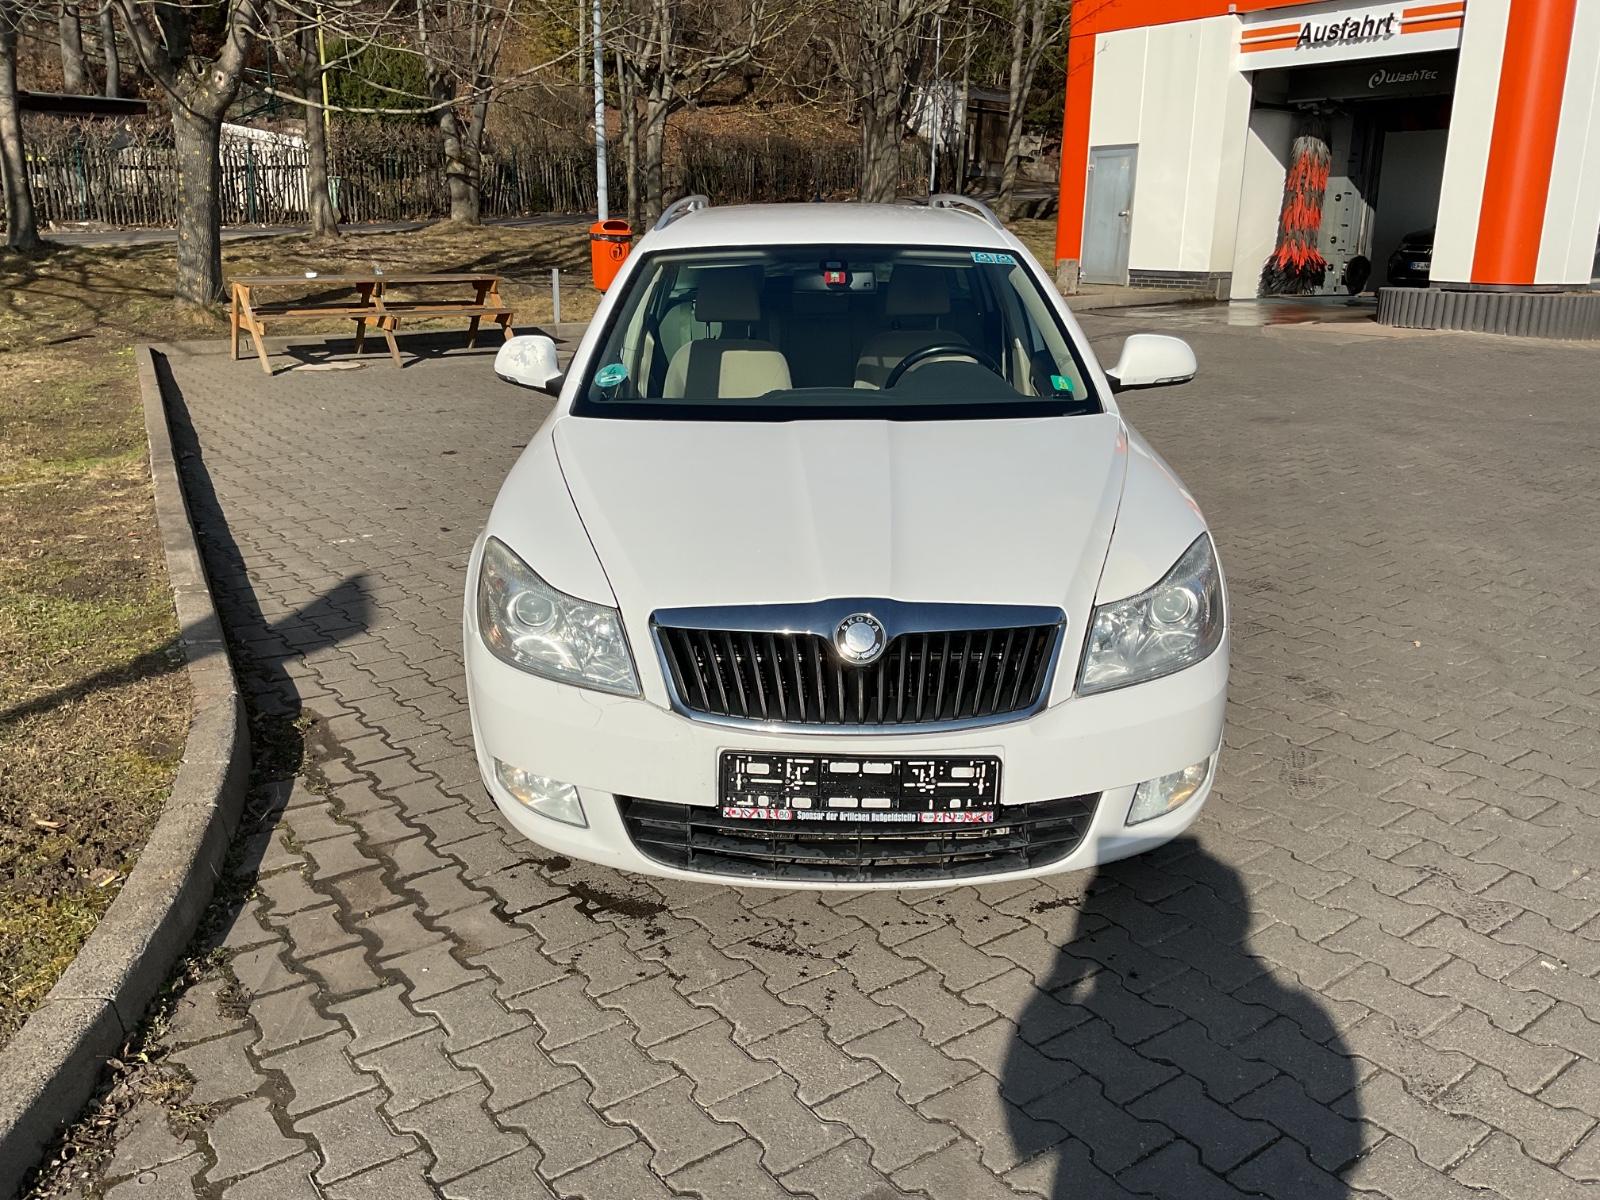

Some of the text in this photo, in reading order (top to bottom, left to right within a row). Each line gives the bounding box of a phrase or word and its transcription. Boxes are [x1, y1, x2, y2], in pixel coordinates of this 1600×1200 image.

[1297, 12, 1395, 45] Ausfahrt
[796, 810, 825, 821] Sponsor
[826, 811, 839, 821] der
